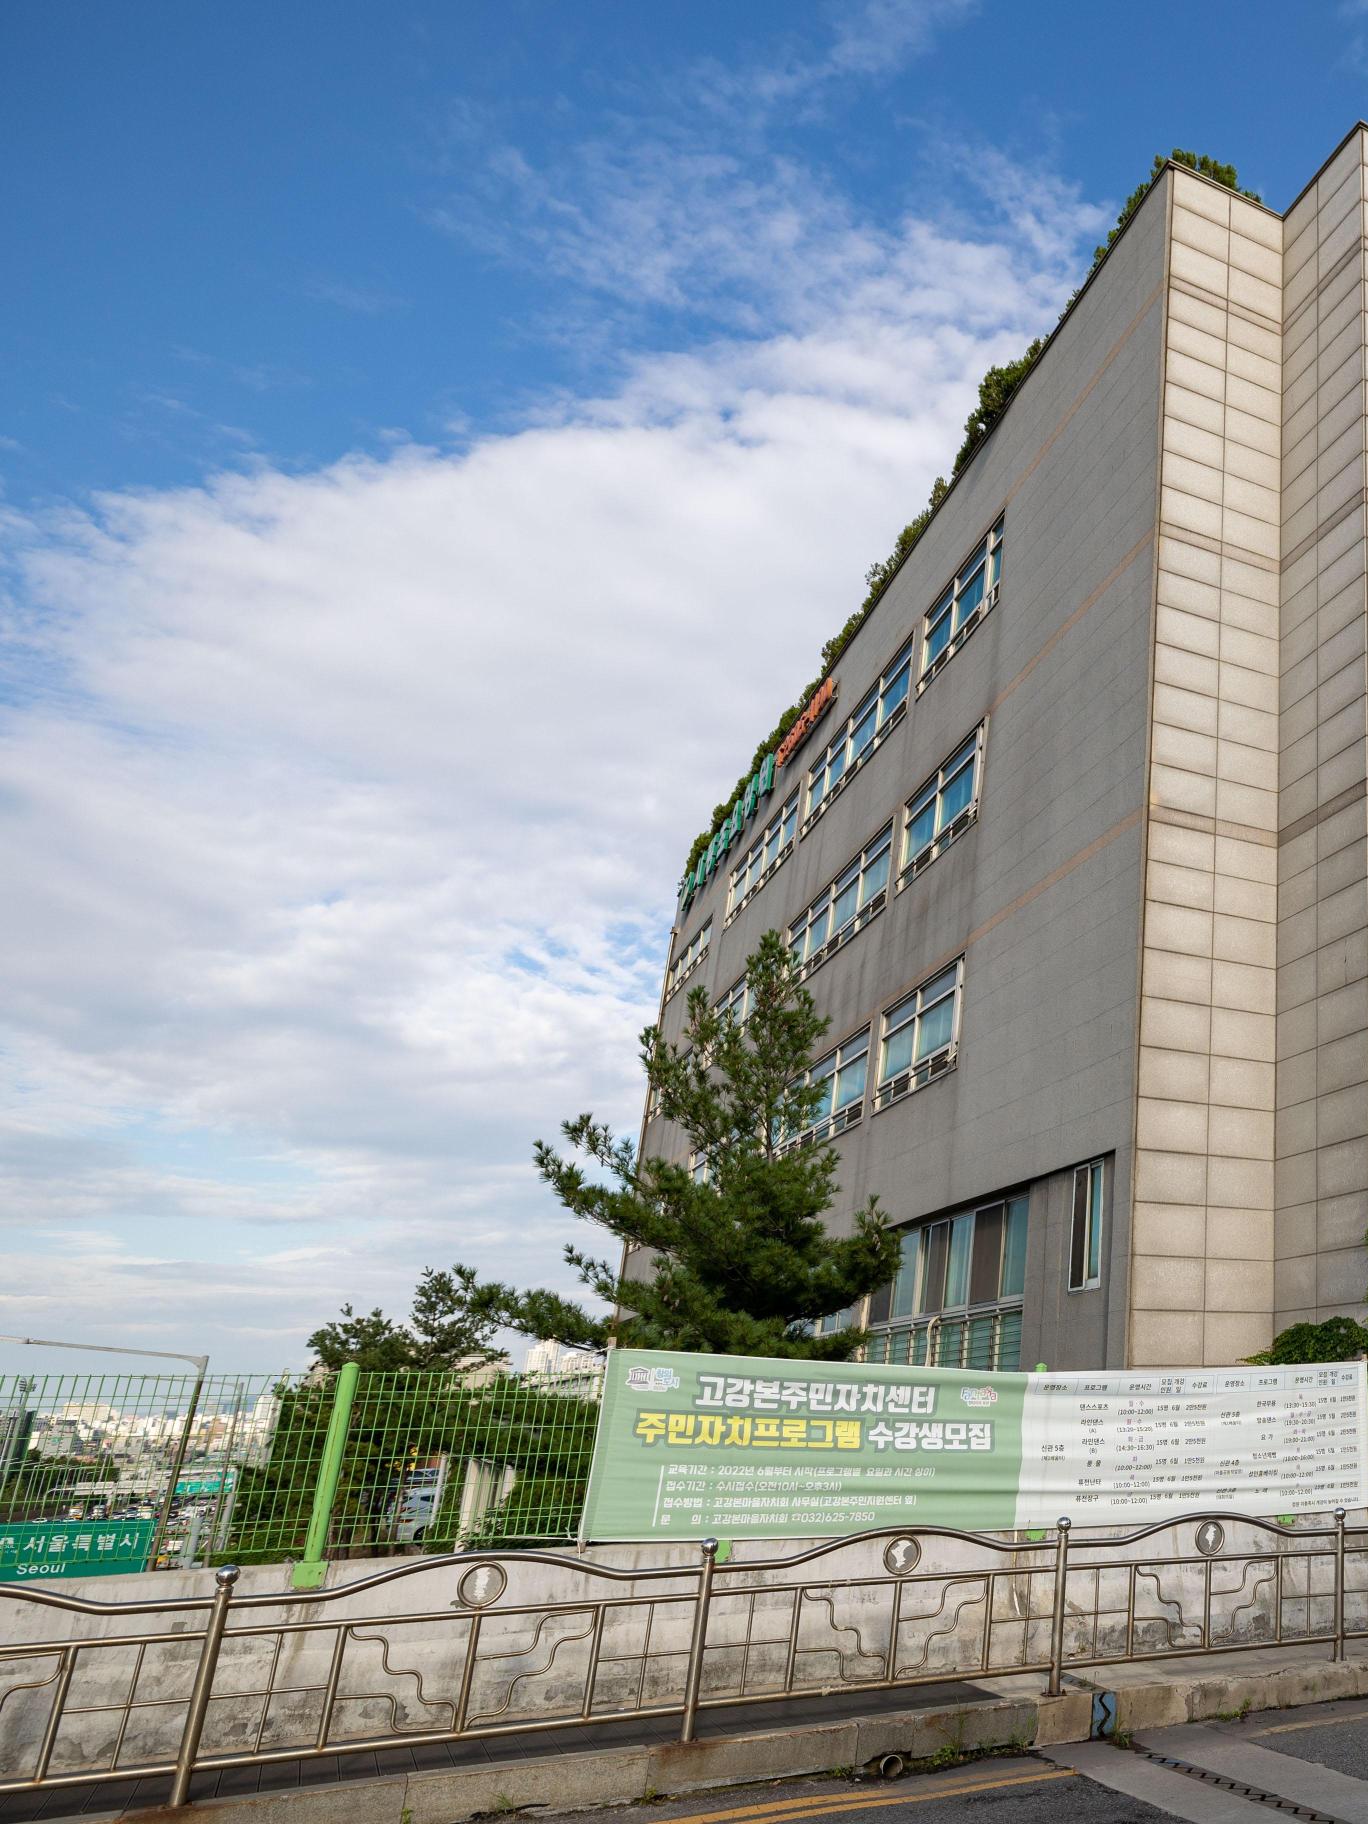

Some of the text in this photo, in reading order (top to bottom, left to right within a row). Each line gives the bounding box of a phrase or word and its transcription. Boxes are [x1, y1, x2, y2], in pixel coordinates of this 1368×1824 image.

[696, 1376, 935, 1414] 고강본주민자치센터
[1080, 1403, 1109, 1411] 댄스스포츠
[636, 1412, 991, 1450] 주민자치프로그램 수강생모집
[1041, 1444, 1065, 1452] 신관 5층
[667, 1464, 708, 1476] 교육기간
[718, 1465, 755, 1476] 2022년
[757, 1465, 792, 1477] 6월부터
[894, 1467, 912, 1477] 시간
[665, 1480, 706, 1491] 접수기간
[663, 1496, 703, 1508] 접수방법
[23, 1532, 140, 1553] 서울특별시
[16, 1563, 66, 1575] Seoul
